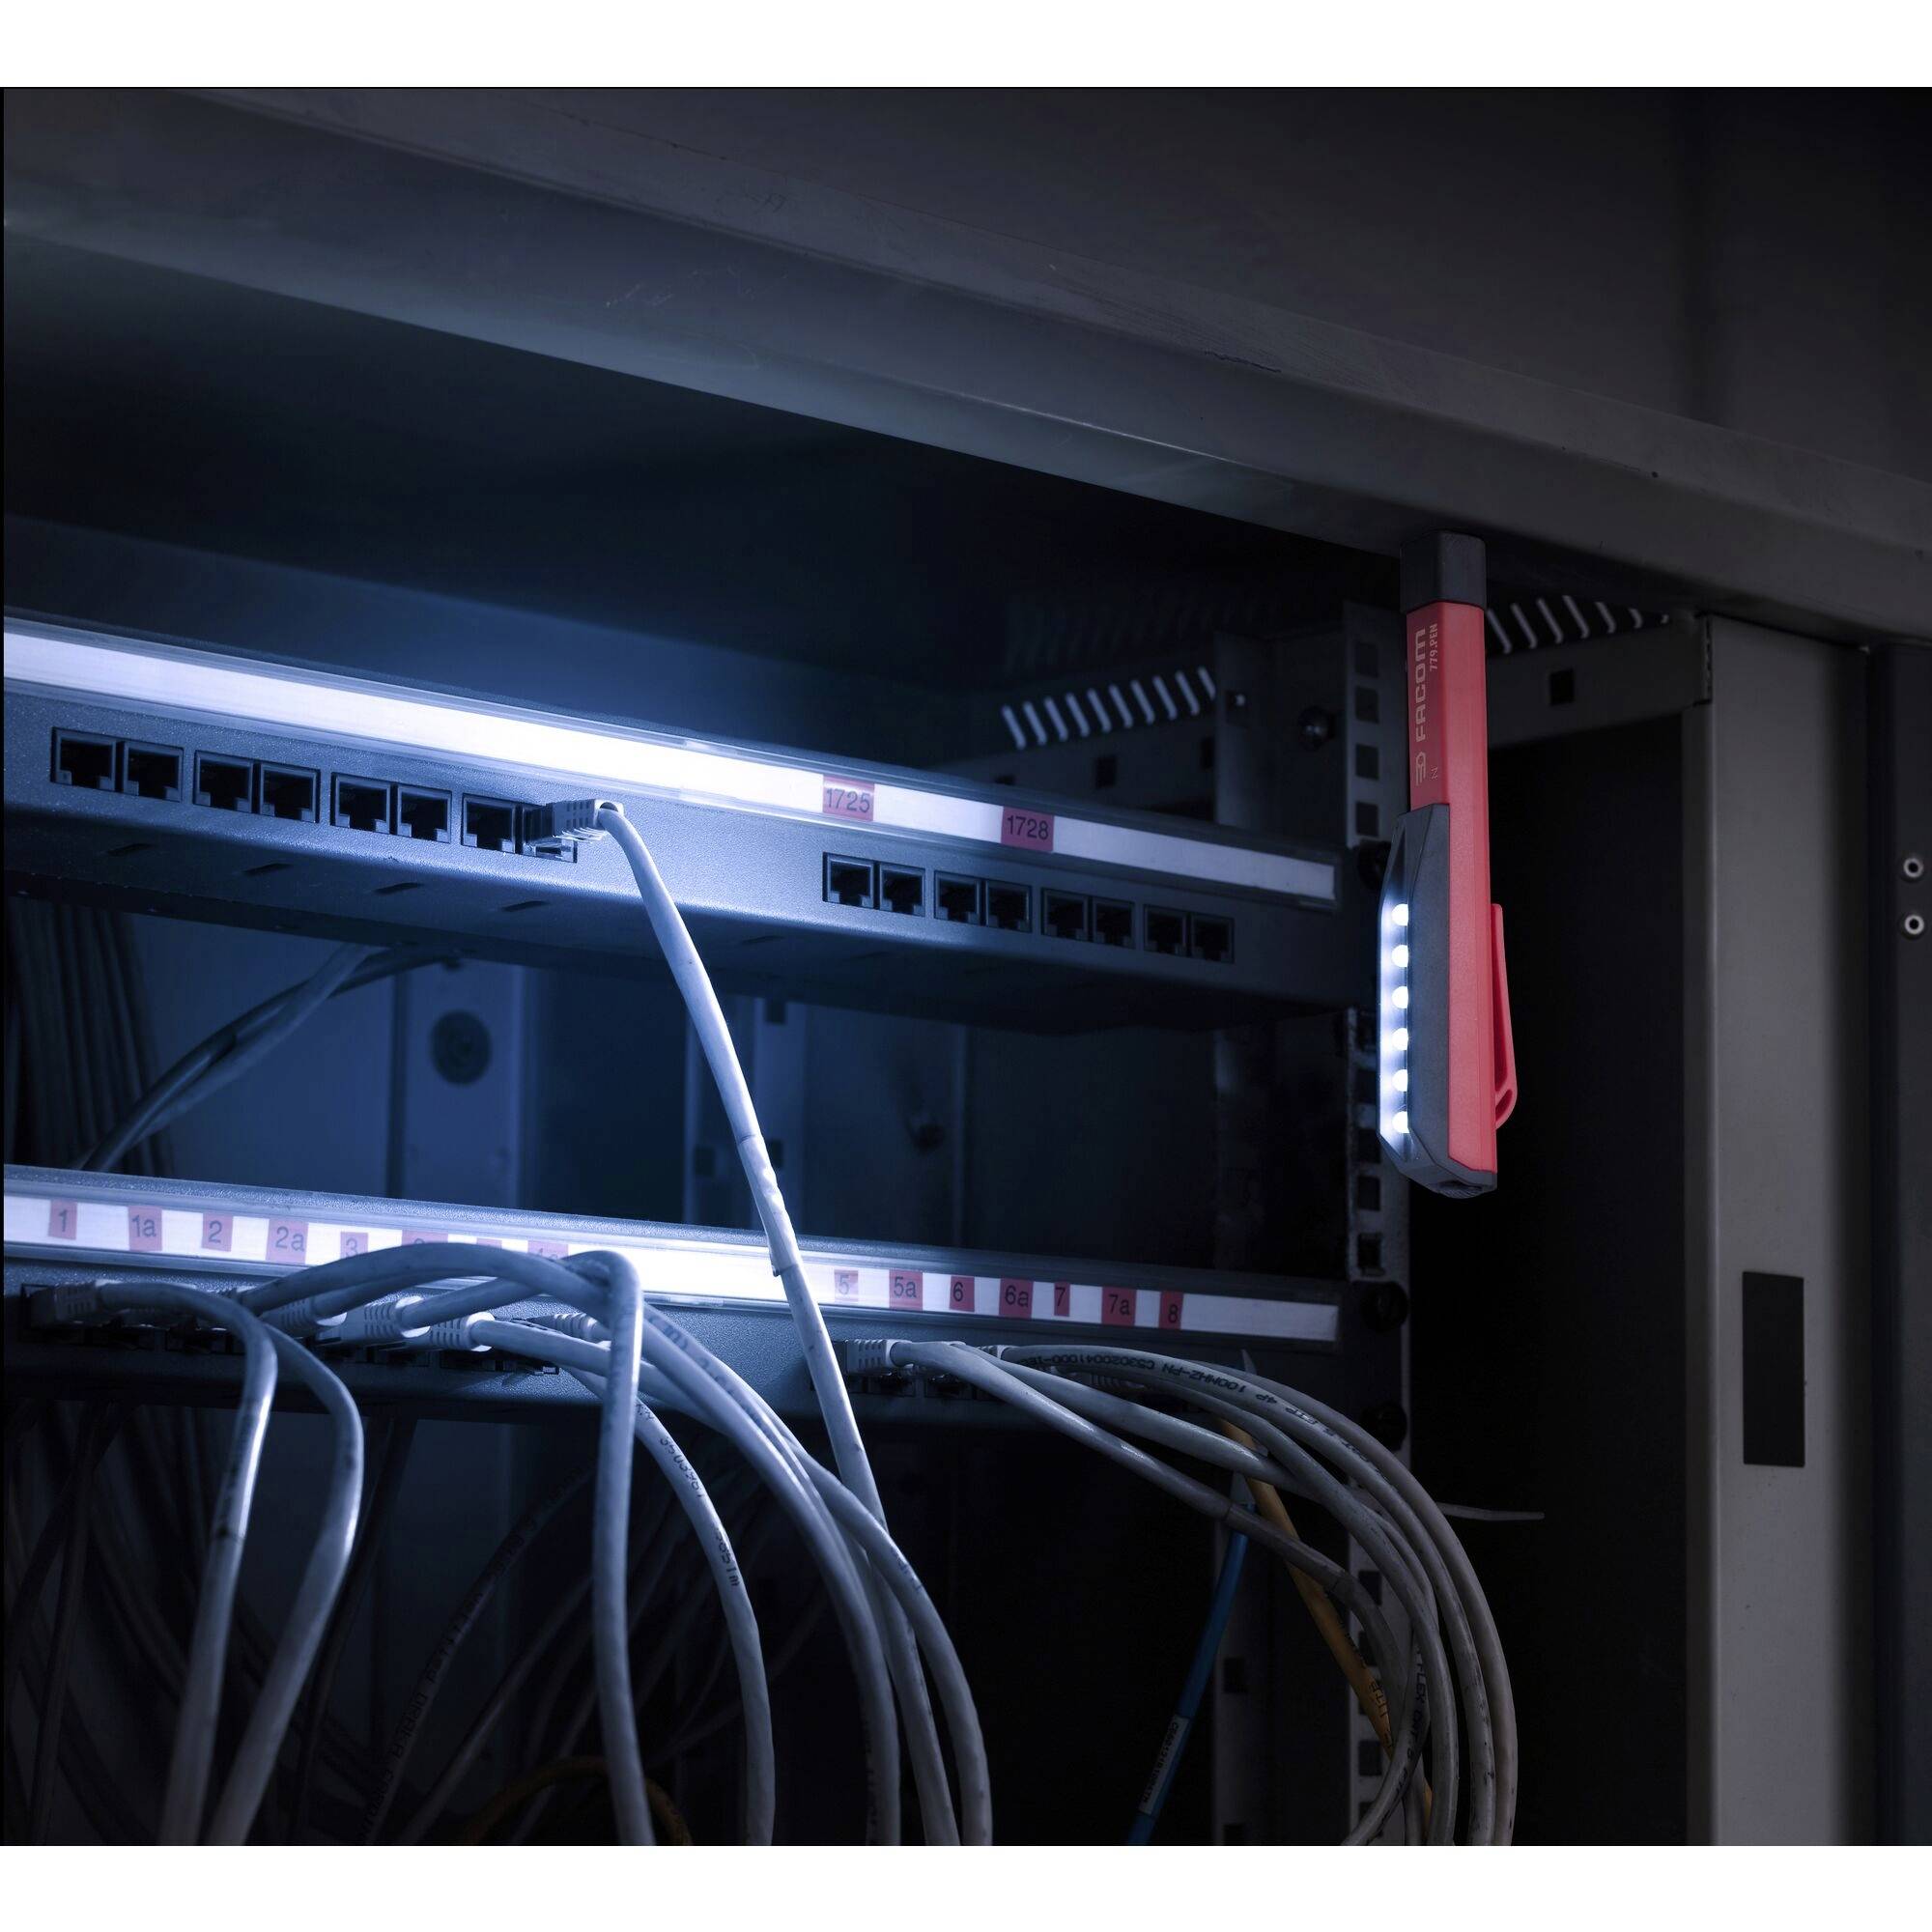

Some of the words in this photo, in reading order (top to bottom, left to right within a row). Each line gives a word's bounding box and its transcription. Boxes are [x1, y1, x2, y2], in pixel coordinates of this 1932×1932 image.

[1430, 623, 1438, 673] 779.PEN
[1415, 628, 1427, 743] FACOM
[826, 788, 870, 813] 1725
[1007, 815, 1049, 840] 1728
[58, 1209, 69, 1232] 1
[131, 1214, 156, 1237] 1a
[208, 1219, 222, 1243] 2
[275, 1225, 304, 1252] 2a
[345, 1236, 358, 1258] 3
[838, 1274, 850, 1295] 5
[894, 1275, 917, 1298] 5a
[952, 1281, 964, 1302] 6
[1004, 1284, 1029, 1308] 6a
[1055, 1286, 1066, 1307] 7
[1108, 1293, 1130, 1316] 7a
[1168, 1303, 1179, 1323] 8
